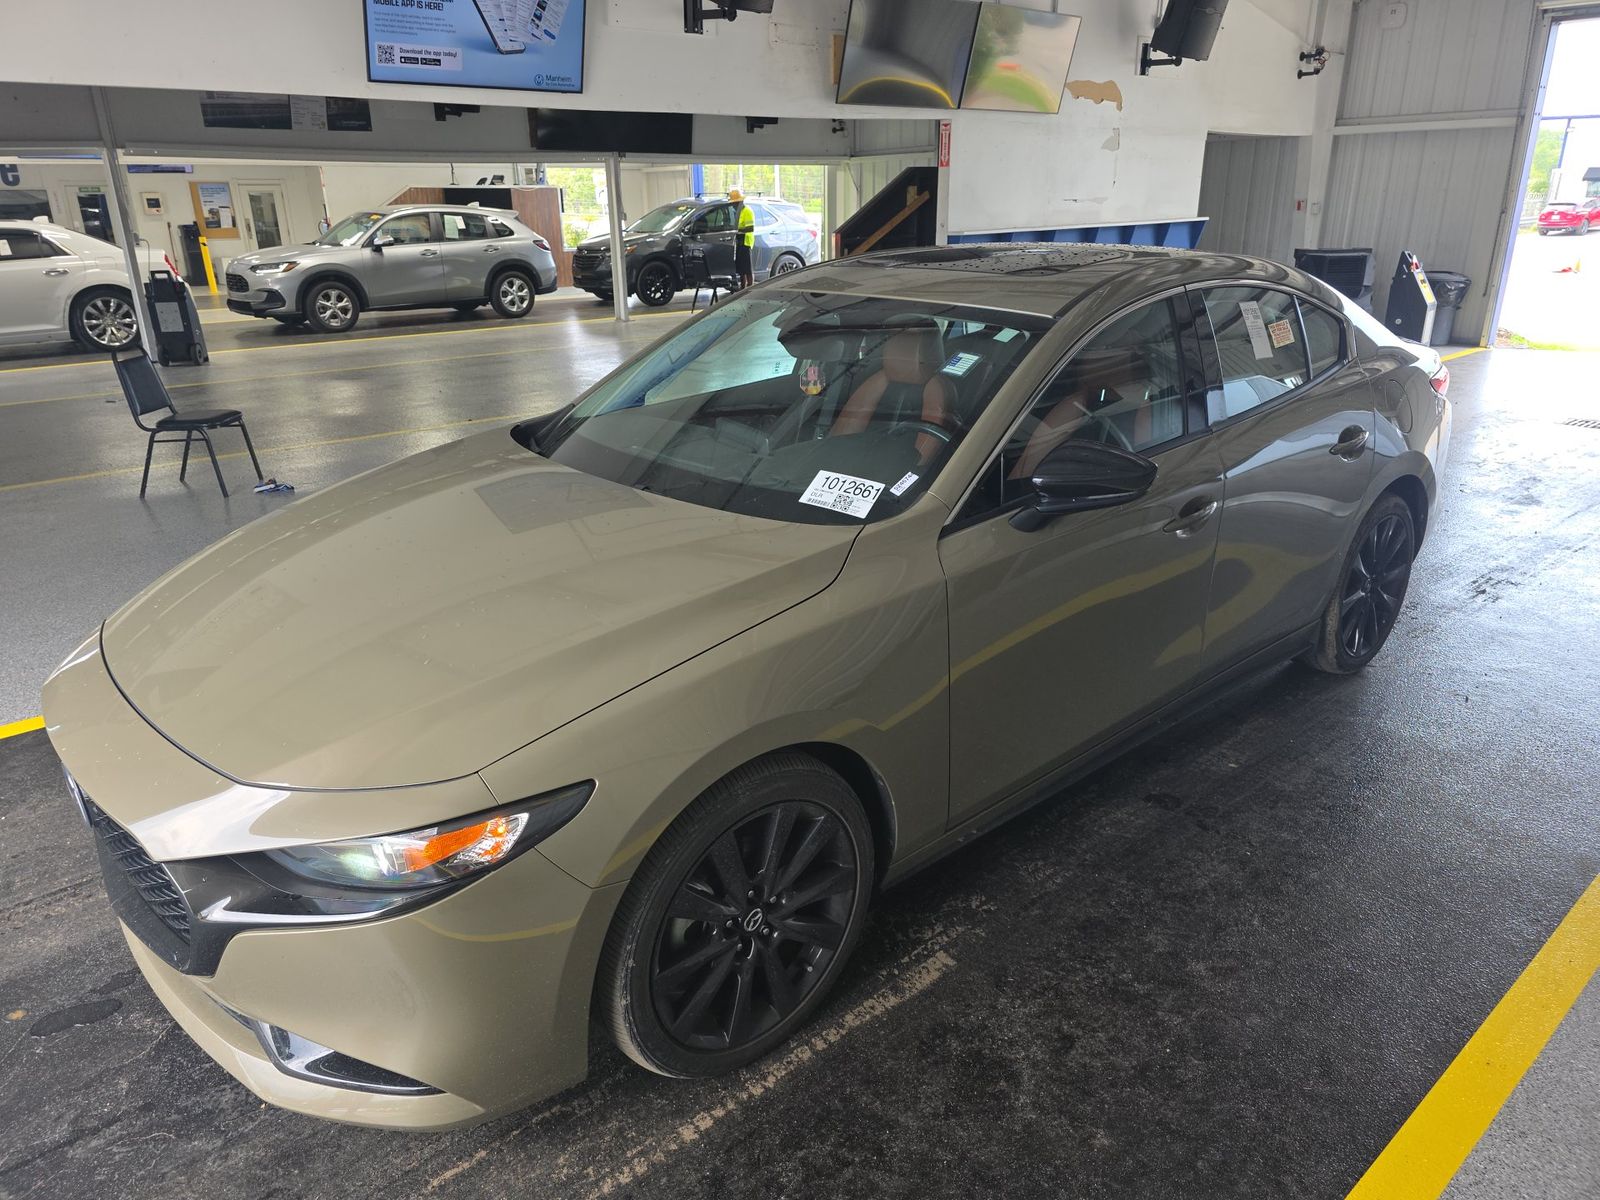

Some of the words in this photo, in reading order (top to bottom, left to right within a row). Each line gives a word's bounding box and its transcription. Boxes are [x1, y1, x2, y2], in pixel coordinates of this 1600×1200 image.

[401, 0, 415, 8] APP
[417, 1, 424, 9] IS
[425, 2, 443, 10] HERE!
[822, 476, 881, 500] 1012661
